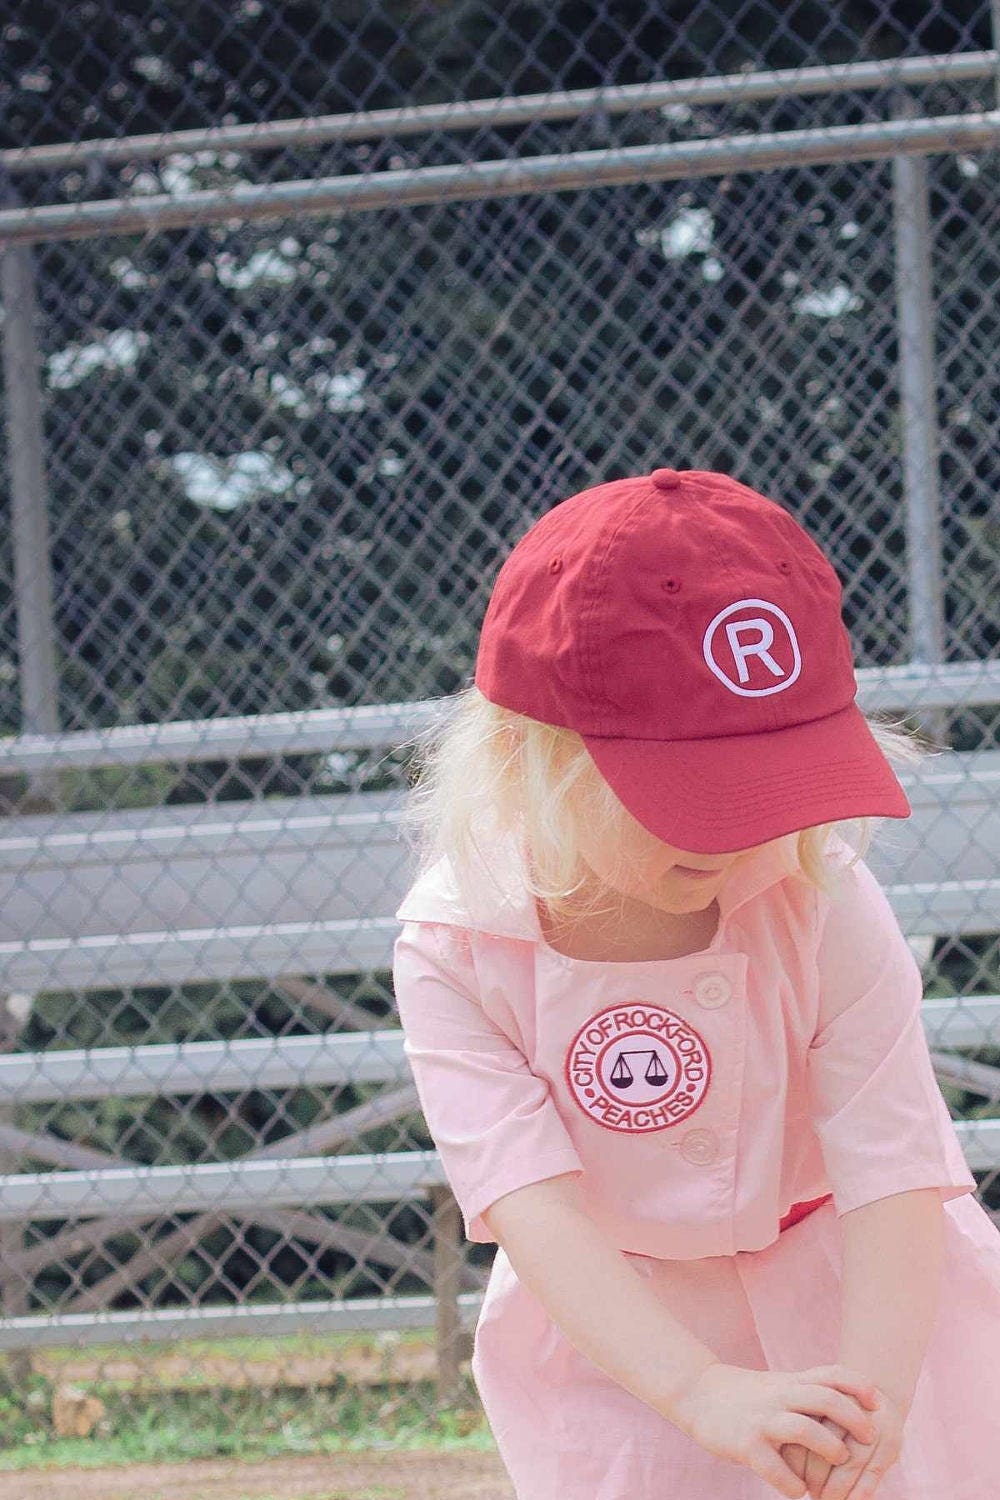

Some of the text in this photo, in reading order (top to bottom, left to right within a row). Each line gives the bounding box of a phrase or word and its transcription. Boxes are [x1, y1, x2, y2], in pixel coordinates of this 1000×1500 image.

[573, 1009, 704, 1087] CITY OF ROCKFORD
[588, 1091, 695, 1128] PEACHES
